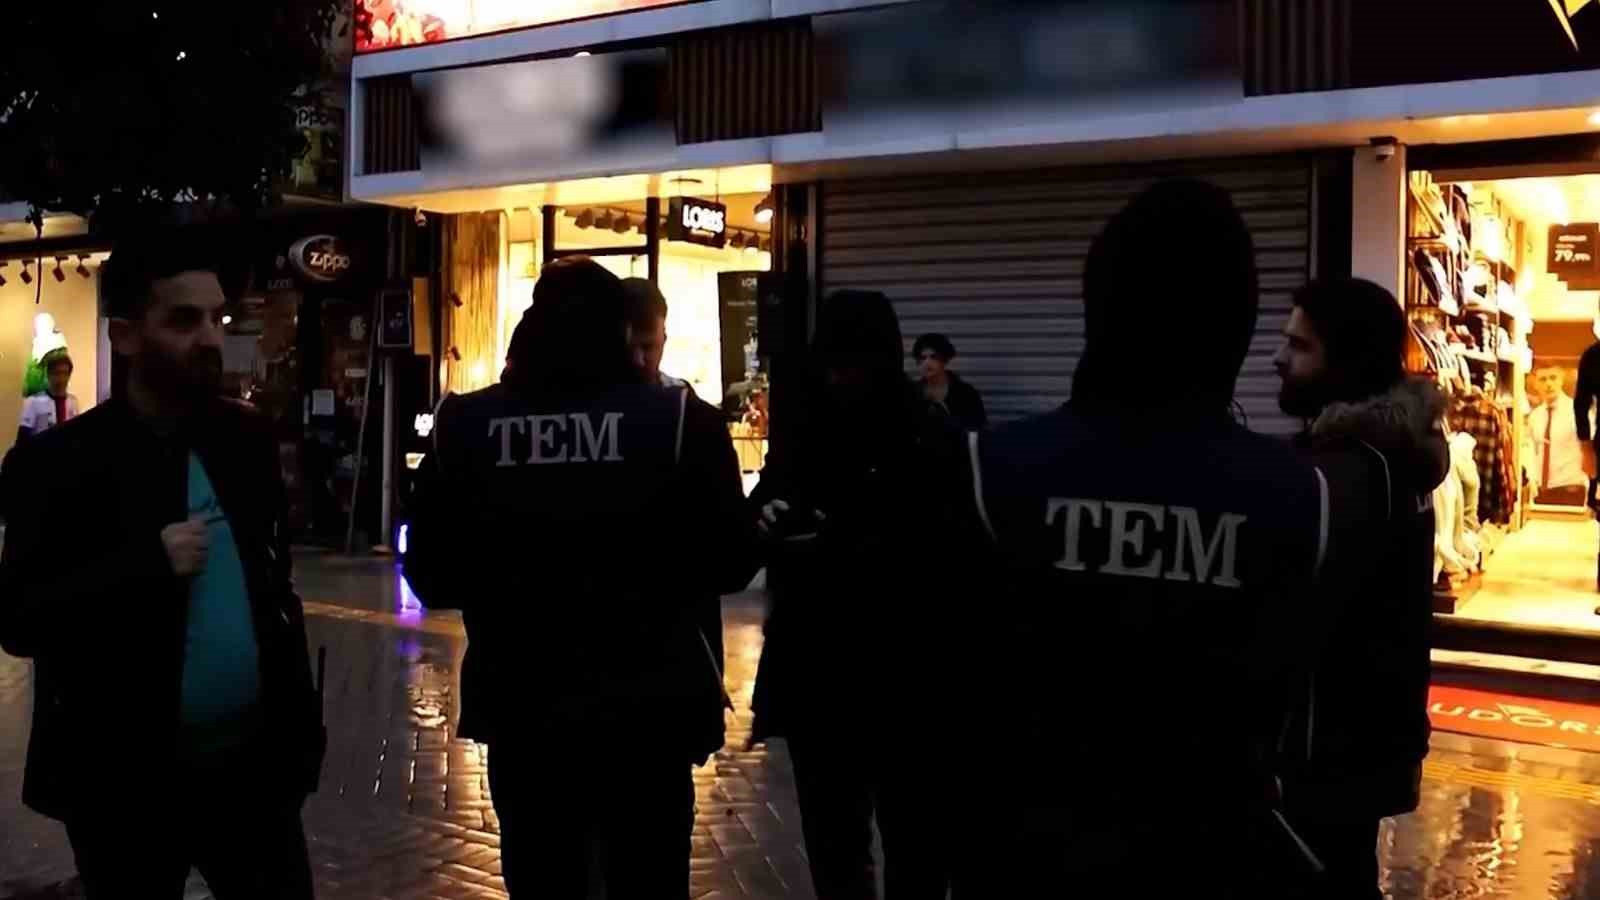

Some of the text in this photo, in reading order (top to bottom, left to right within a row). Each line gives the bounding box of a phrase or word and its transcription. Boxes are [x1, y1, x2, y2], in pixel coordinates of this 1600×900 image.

[310, 251, 351, 272] Zippo
[488, 411, 625, 468] TEM
[1044, 496, 1248, 589] TEM
